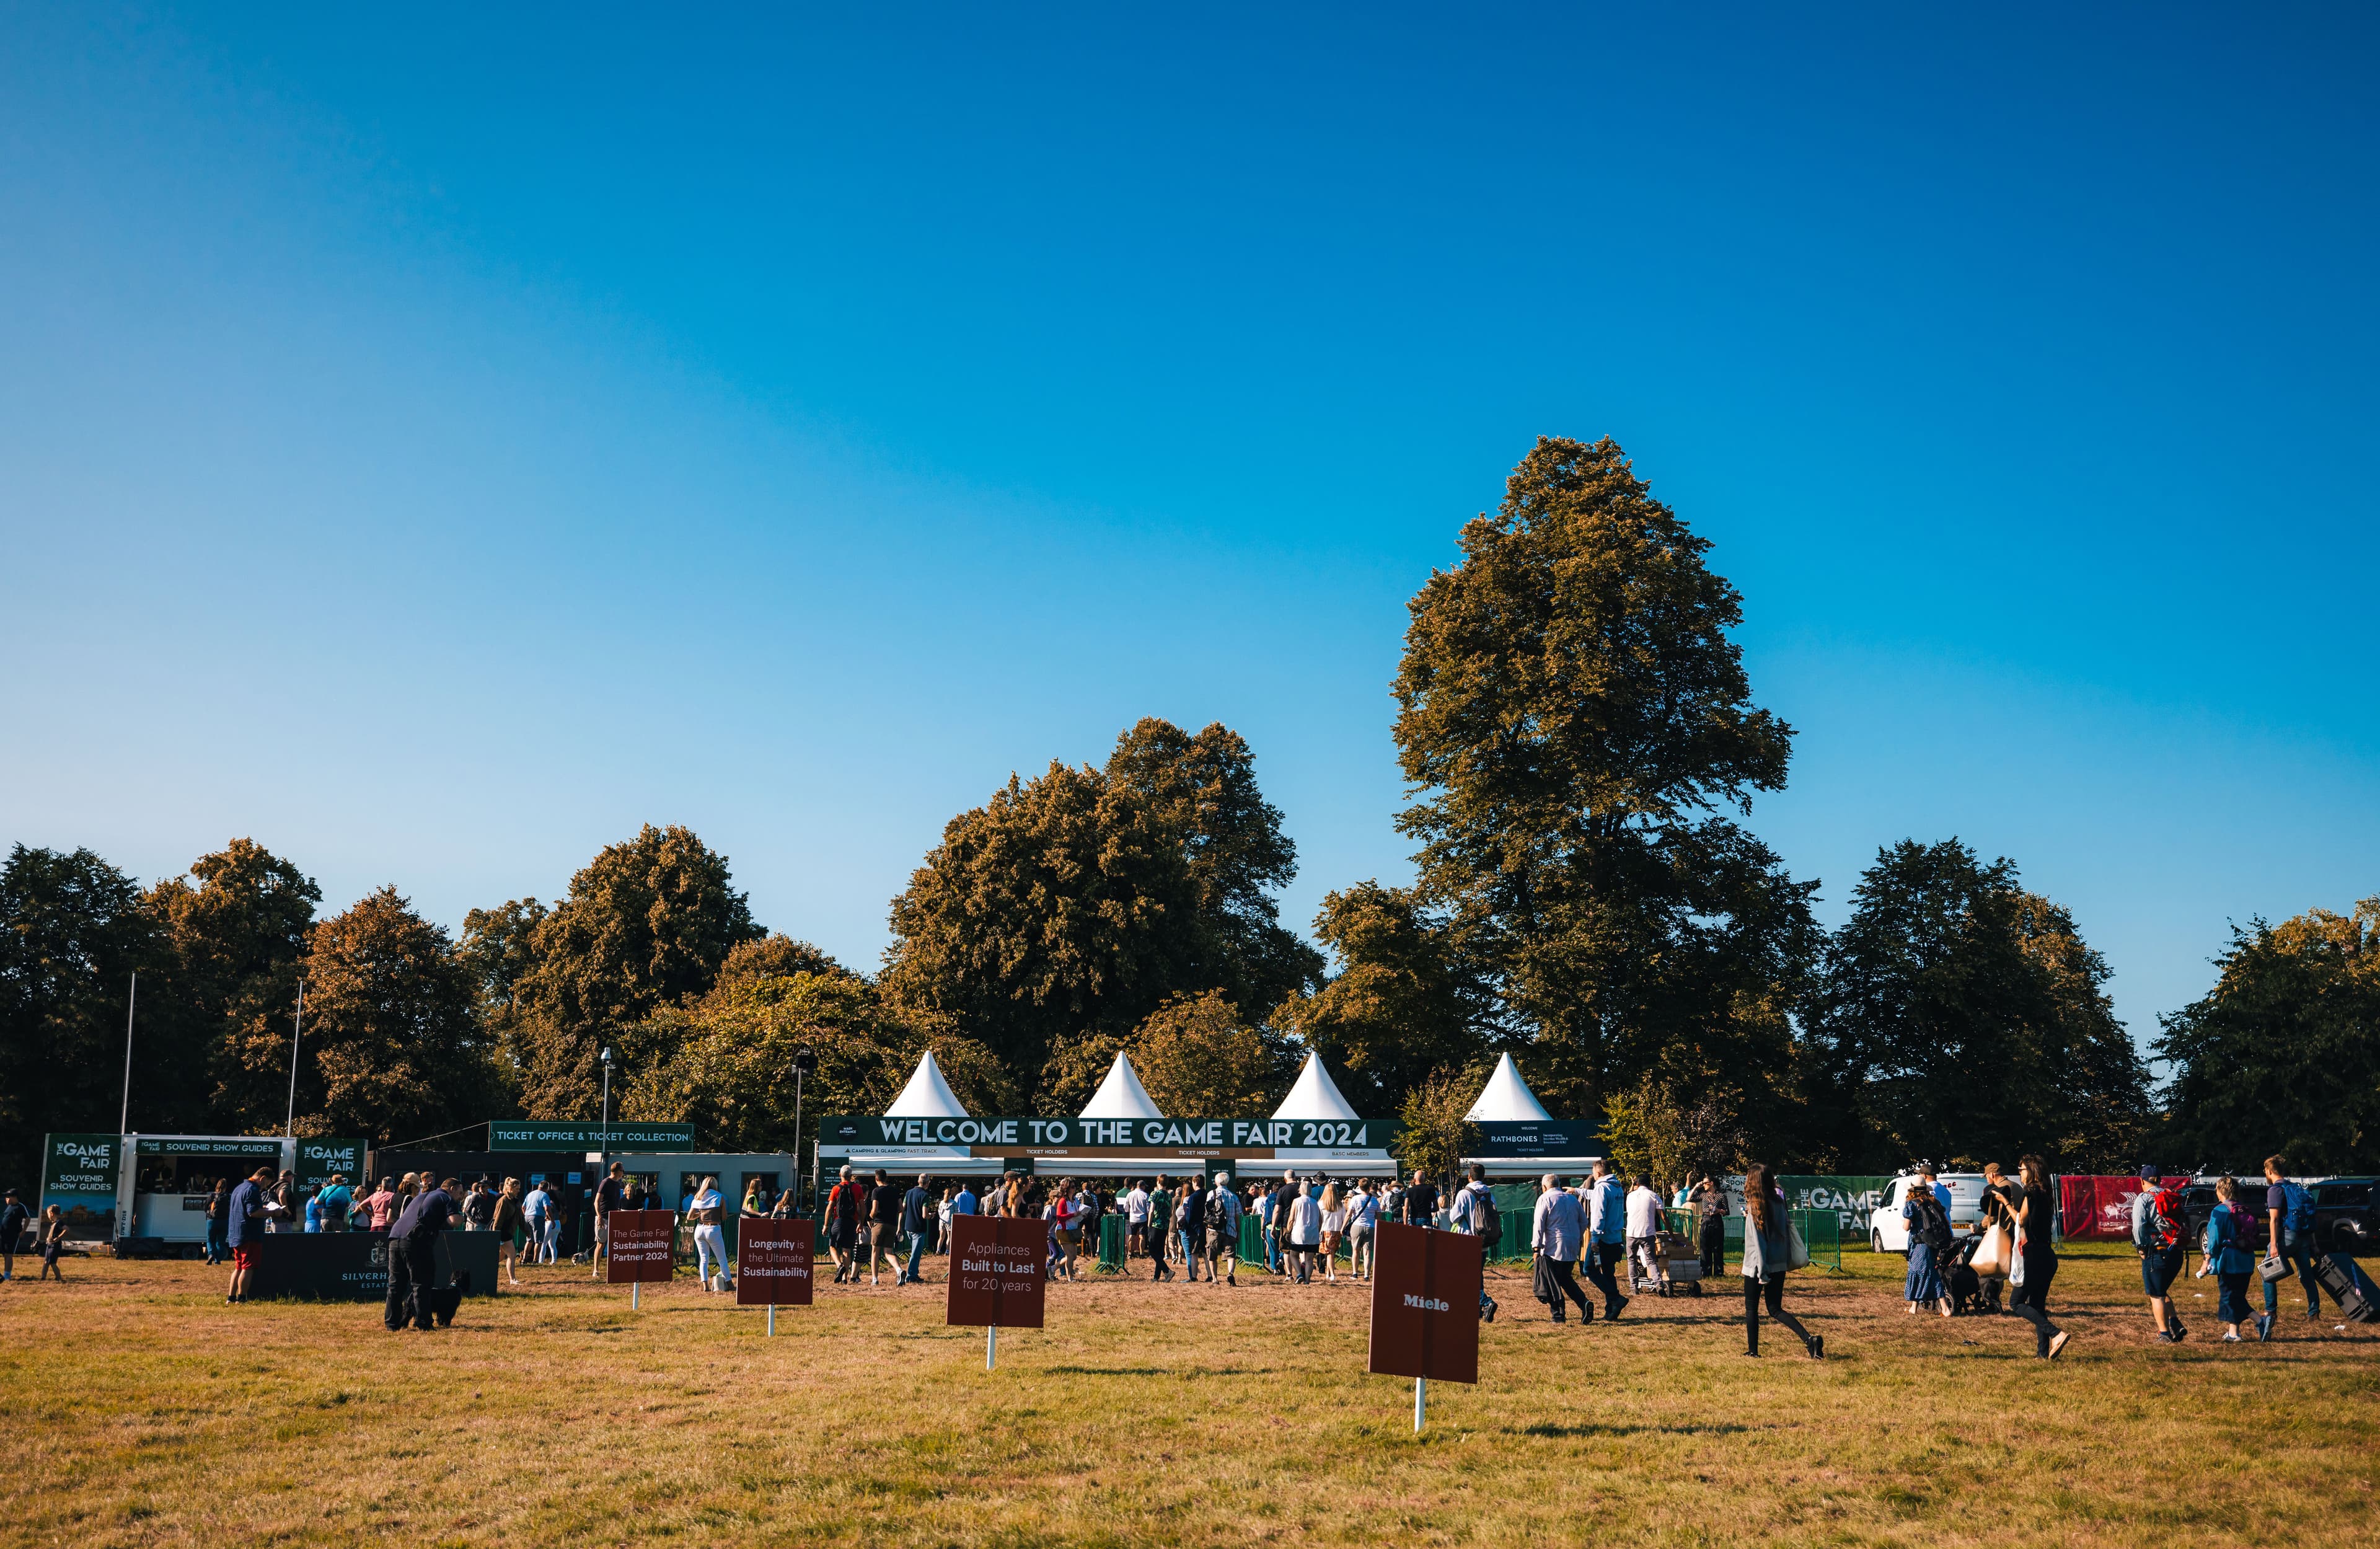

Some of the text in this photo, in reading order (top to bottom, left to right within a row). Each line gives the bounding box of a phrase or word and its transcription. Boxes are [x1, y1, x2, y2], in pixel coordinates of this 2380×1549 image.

[497, 1131, 689, 1142] TICKET OFFICE & TICKET COLLECTION
[879, 1120, 1367, 1146] WELCOME TO THE GAME FAIR 2024
[63, 1142, 110, 1157] GAME
[311, 1146, 355, 1159] GAME
[81, 1157, 110, 1169] FAIR
[327, 1160, 354, 1171] FAIR
[1800, 1188, 1809, 1209] THE
[1810, 1187, 1879, 1209] GAME
[1839, 1212, 1871, 1230] FAI
[612, 1230, 627, 1238] The
[656, 1229, 669, 1237] Fair
[613, 1240, 669, 1250] Sustainability
[749, 1239, 804, 1251] Longevity is
[967, 1242, 1030, 1256] Appliances
[613, 1251, 668, 1261] Partner 2024
[749, 1253, 804, 1263] the Ultimate
[744, 1266, 808, 1279] Sustainability
[962, 1259, 1035, 1274] Built to Last
[342, 1273, 390, 1281] SILVERH
[963, 1276, 1031, 1294] for 20 years
[1403, 1294, 1449, 1312] Miele
